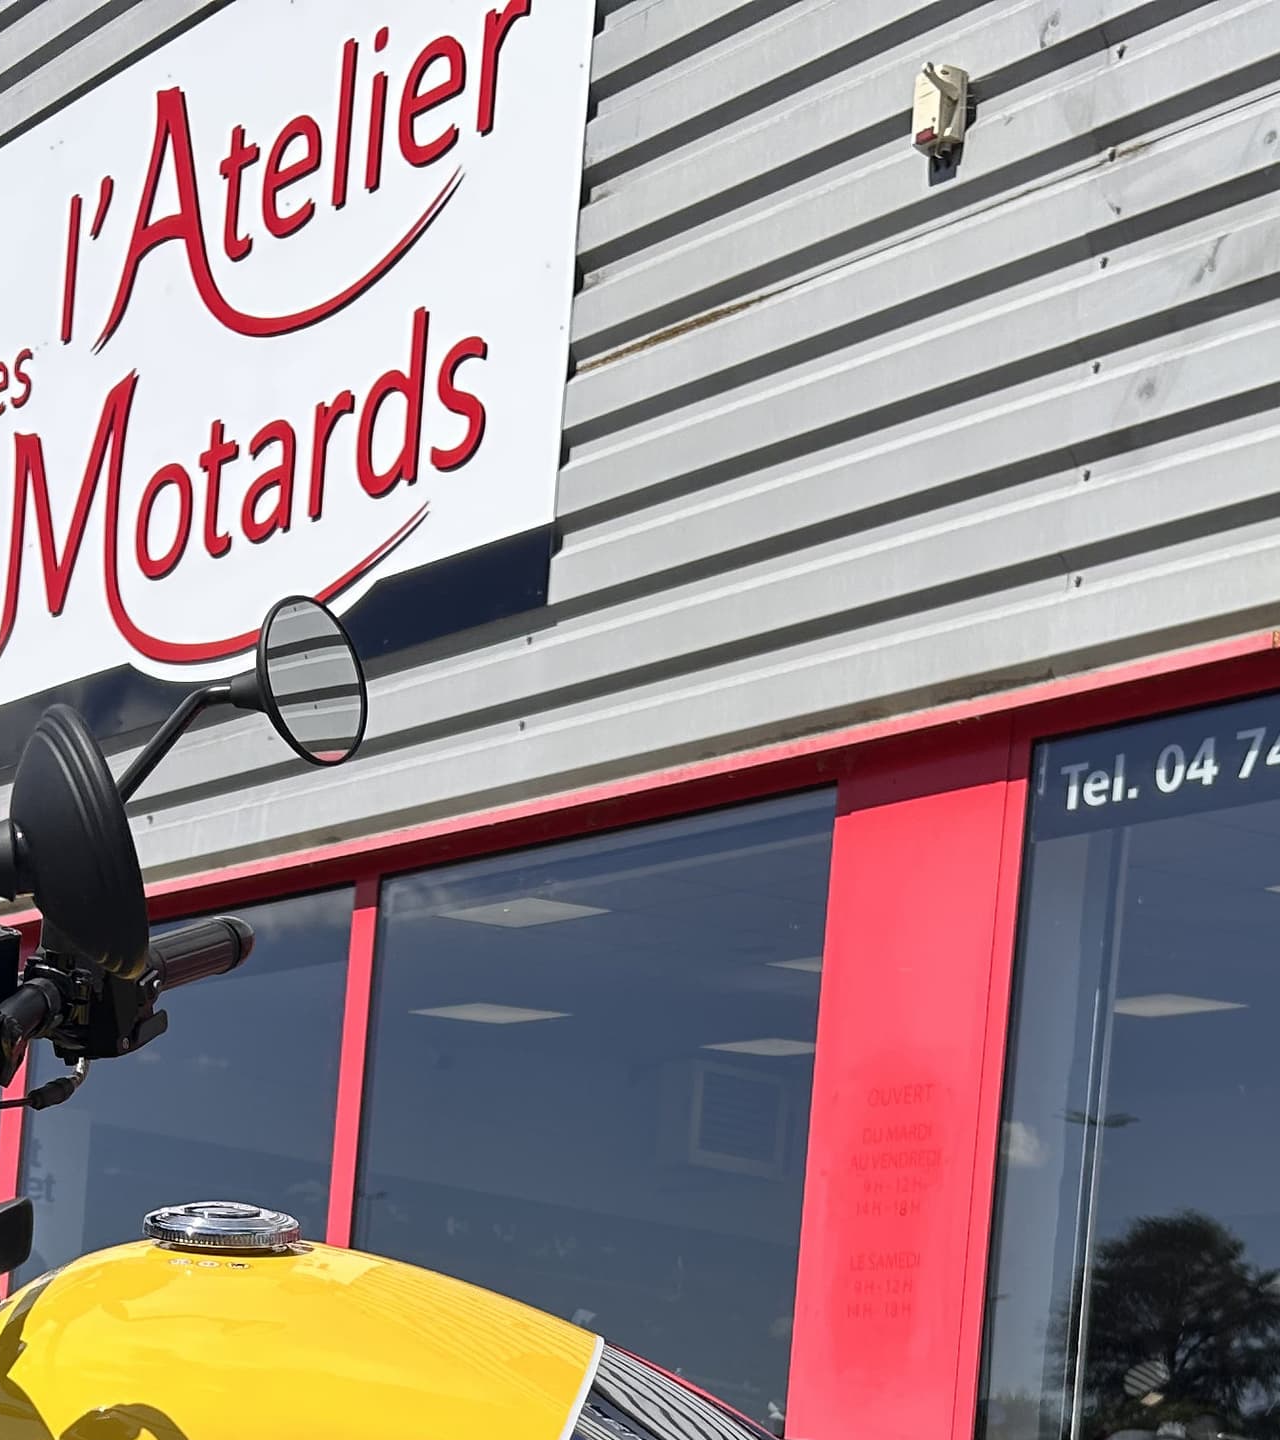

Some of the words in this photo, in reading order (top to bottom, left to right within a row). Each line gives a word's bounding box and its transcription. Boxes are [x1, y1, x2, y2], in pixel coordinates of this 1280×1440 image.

[56, 0, 532, 354] l'Atelier
[1061, 762, 1139, 812] Tel.
[1154, 742, 1218, 795] 04
[866, 1083, 937, 1108] OUVERT
[862, 1126, 883, 1146] DU
[885, 1122, 933, 1143] MARDI
[850, 1152, 869, 1172] AU
[871, 1149, 943, 1170] VENDREDI
[849, 1252, 865, 1272] LE
[867, 1251, 922, 1271] SAMEDI
